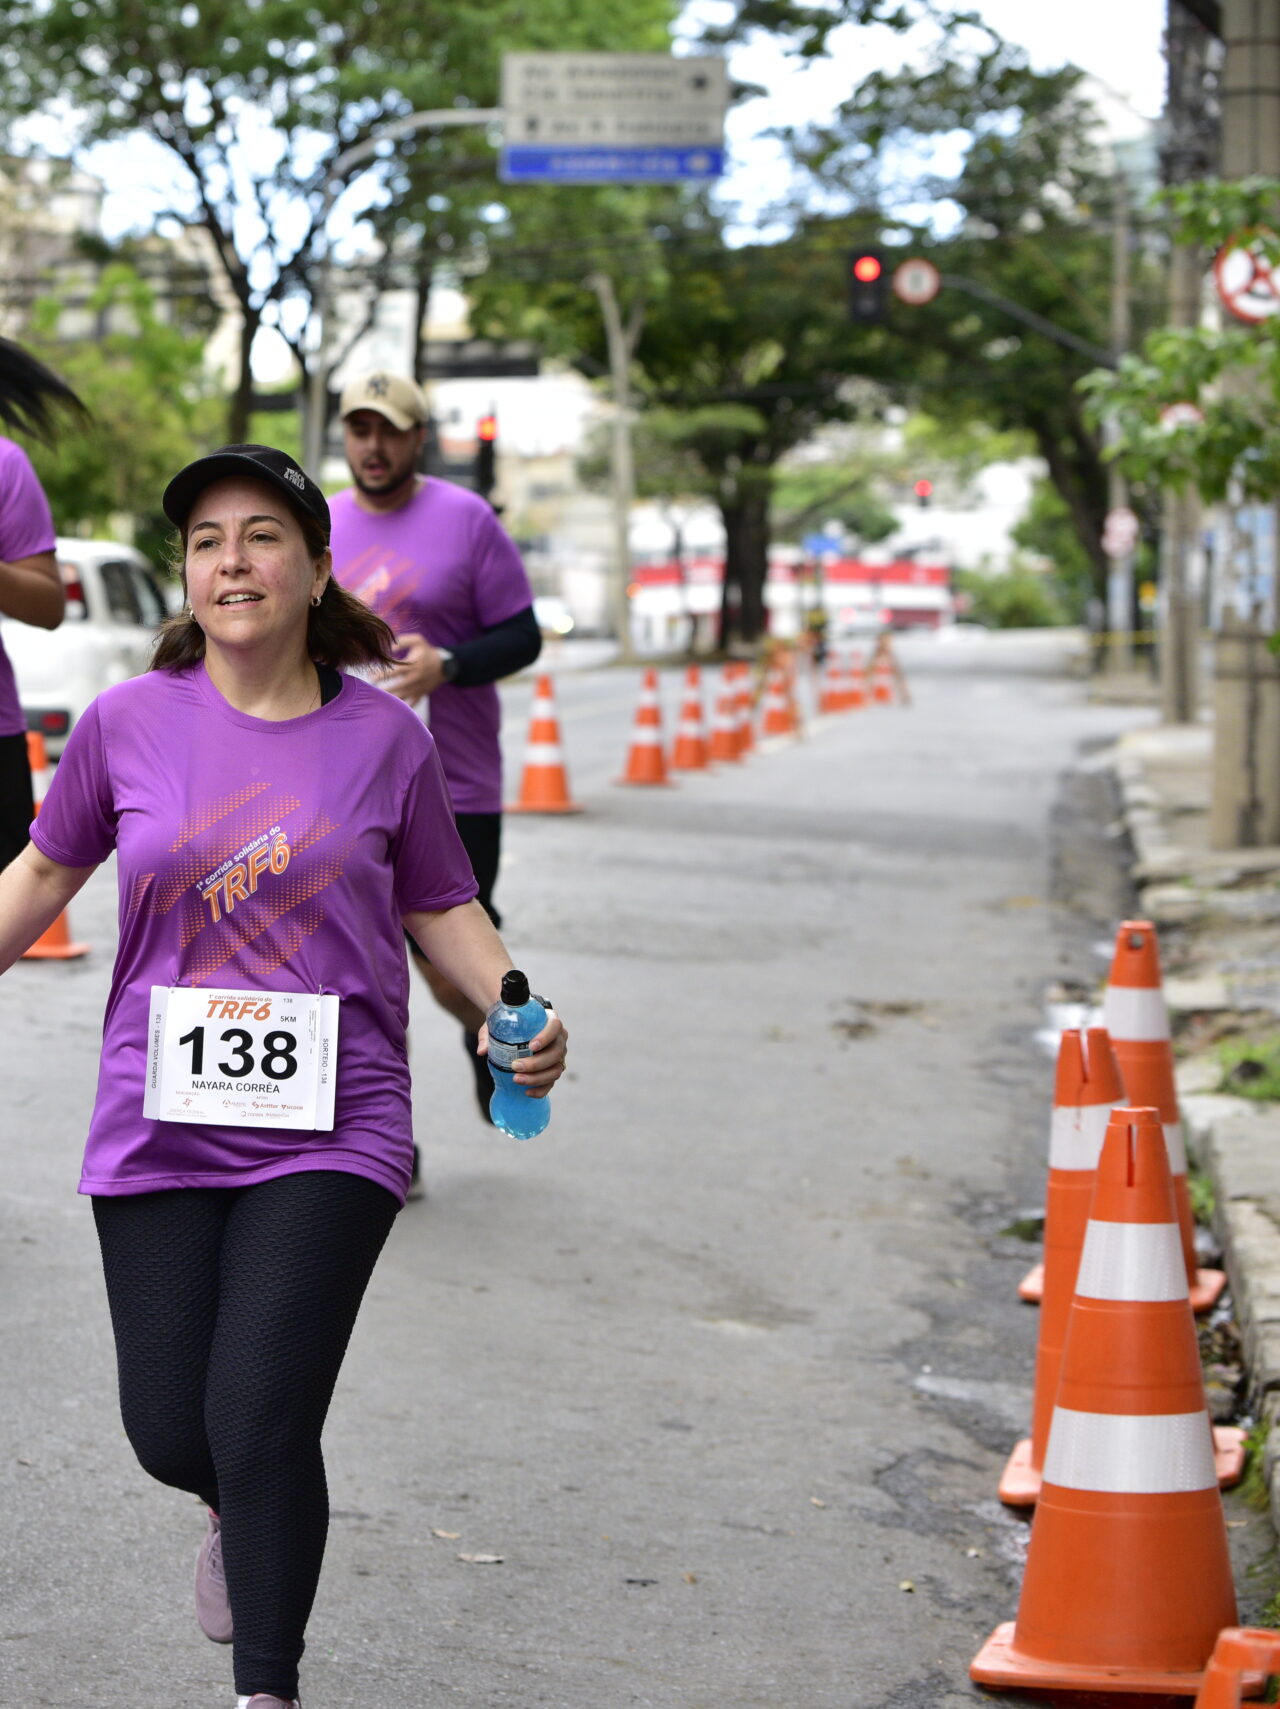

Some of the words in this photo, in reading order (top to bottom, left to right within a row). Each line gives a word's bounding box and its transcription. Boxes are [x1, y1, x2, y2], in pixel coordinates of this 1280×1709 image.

[287, 467, 304, 484] TRACK
[289, 474, 305, 490] FIELD
[205, 860, 233, 885] corrida
[234, 834, 269, 862] solidária
[269, 826, 281, 836] do
[201, 832, 290, 923] TRF6
[206, 1000, 273, 1021] TRF6
[280, 1015, 297, 1023] 5KM
[179, 1026, 298, 1080] 138
[191, 1080, 233, 1091] NAYARA
[236, 1082, 280, 1094] CORRÊA
